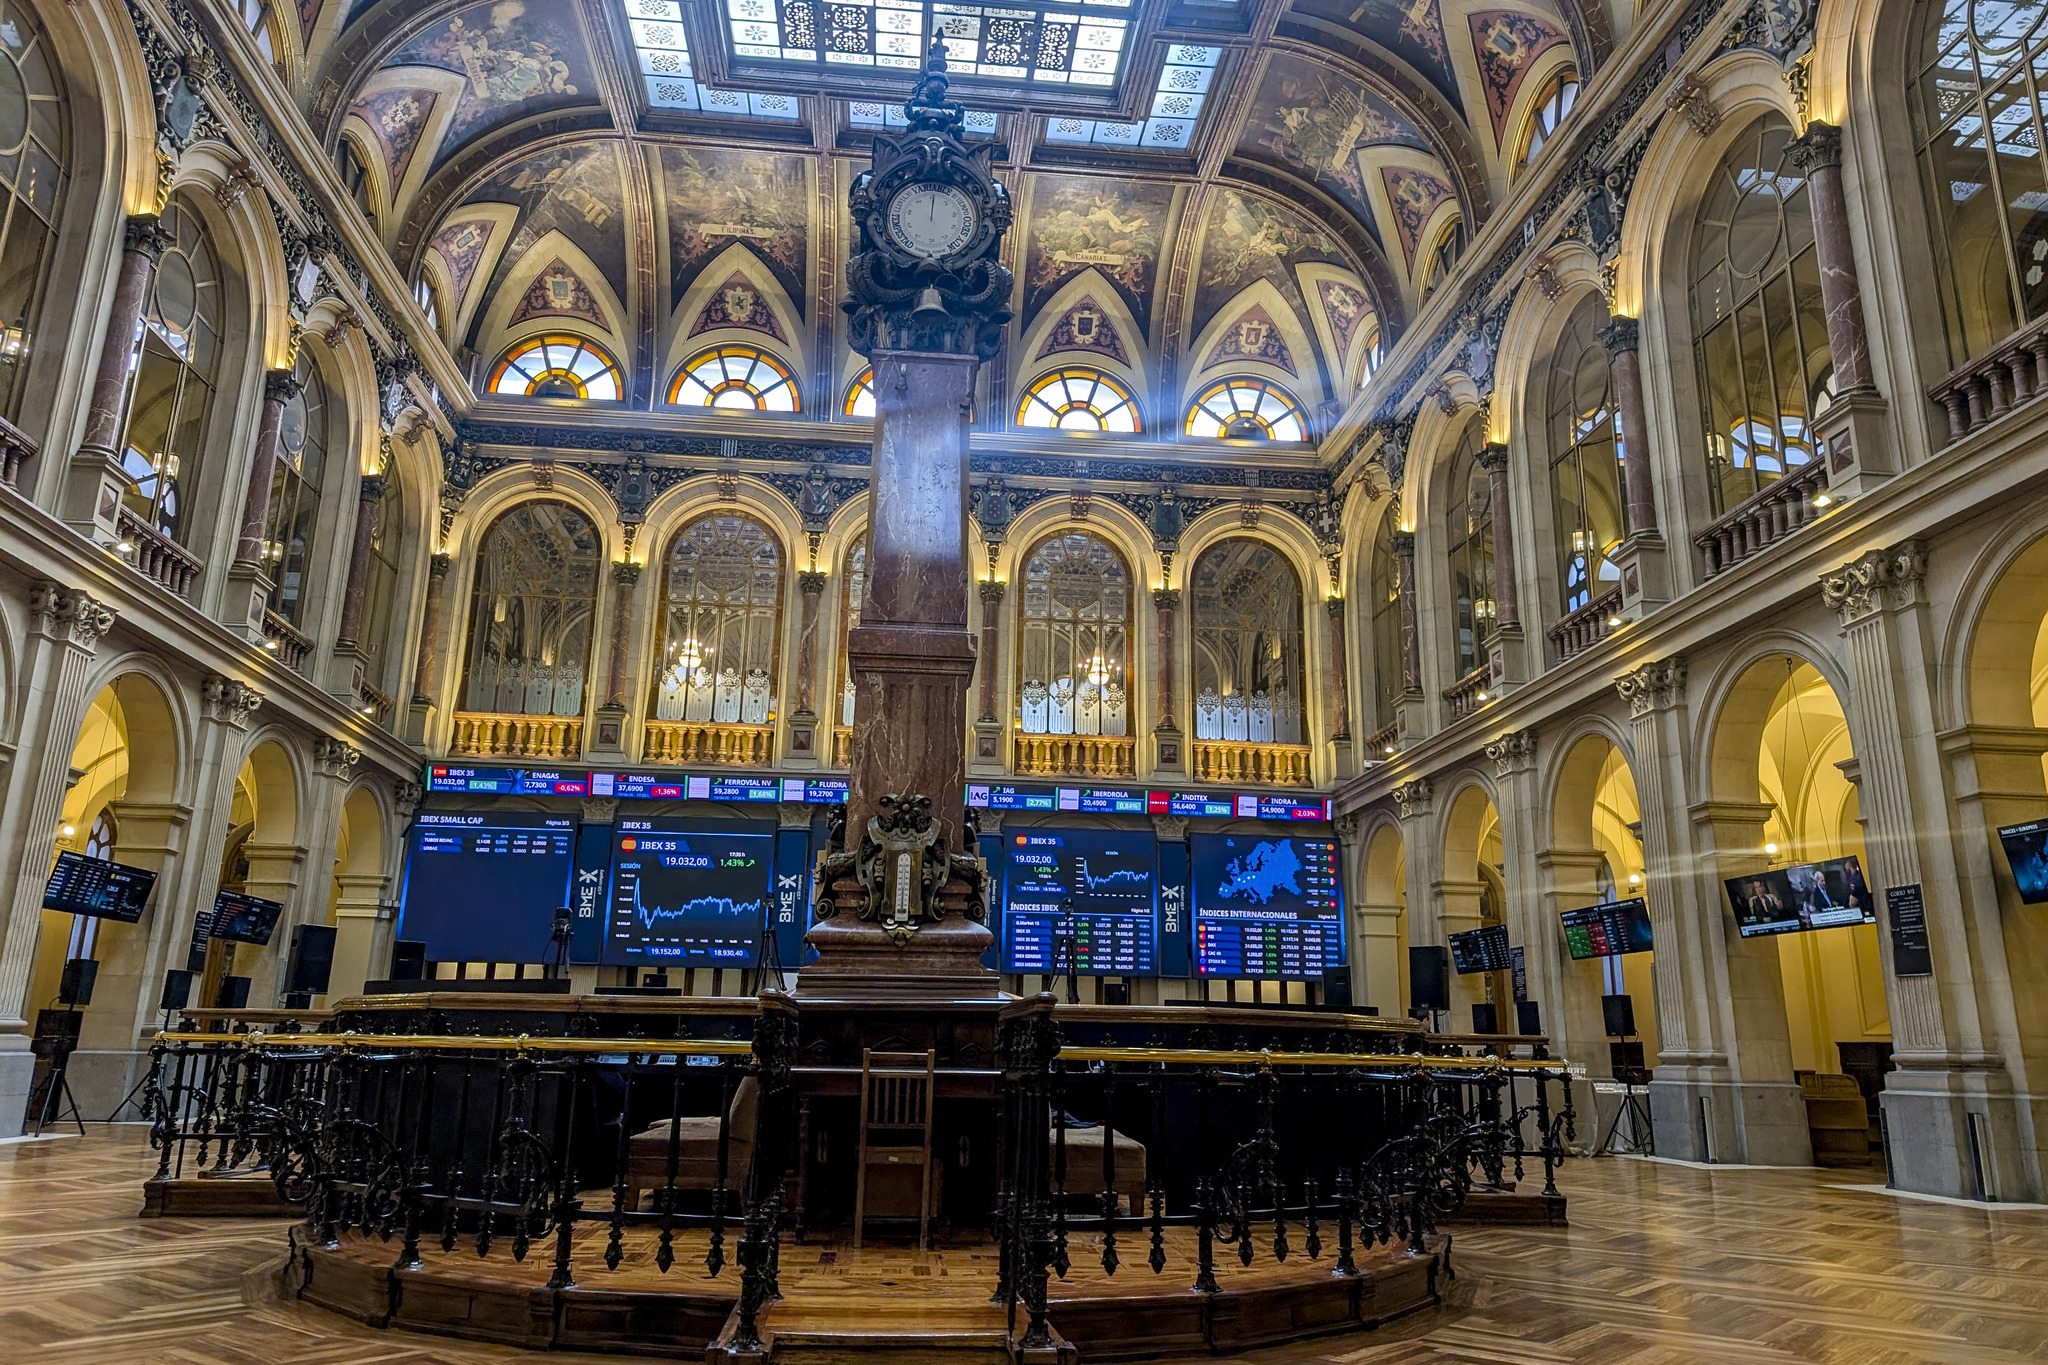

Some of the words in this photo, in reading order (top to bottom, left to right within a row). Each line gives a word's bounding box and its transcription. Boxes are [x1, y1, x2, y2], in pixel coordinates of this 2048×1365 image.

[911, 183, 953, 196] VARIABLE
[956, 197, 970, 216] TIEMPO
[891, 214, 914, 249] TEMPESTAD
[947, 235, 964, 252] MUY
[960, 215, 972, 237] SECO
[1075, 253, 1109, 262] CANARIAS.
[434, 778, 465, 786] 19.032,00
[629, 775, 655, 783] ENDESA
[725, 779, 761, 787] FERROVIAL
[473, 781, 494, 789] 1,43%
[618, 784, 643, 792] 37,6900
[819, 781, 848, 789] FLUIDRA
[714, 788, 739, 796] 59,2800
[752, 790, 773, 798] 1,68%
[809, 790, 834, 798] 19,2700
[970, 791, 988, 800] IAG
[1093, 790, 1128, 798] IBERDROLA
[993, 796, 1013, 804] 5,1900
[1182, 794, 1208, 802] INDITEX
[1271, 797, 1291, 805] INDRA
[1083, 799, 1107, 807] 20,4900
[420, 815, 438, 823] IBEX
[440, 816, 466, 824] SMALL
[467, 816, 483, 824] CAP
[622, 821, 640, 829] IBEX
[1031, 837, 1047, 845] IBEX
[641, 841, 663, 850] IBEX
[664, 842, 676, 850] 35
[665, 857, 708, 866] 19.032,00
[720, 858, 744, 867] 1,43%
[1015, 855, 1052, 864] 19.032,00
[578, 886, 594, 918] BME
[779, 891, 793, 923] BME
[1010, 902, 1040, 911] ÍNDICES
[1165, 902, 1176, 932] BME
[1199, 907, 1229, 917] ÍNDICES
[1230, 909, 1297, 919] INTERNACIONALES
[714, 949, 744, 957] 18.930,40
